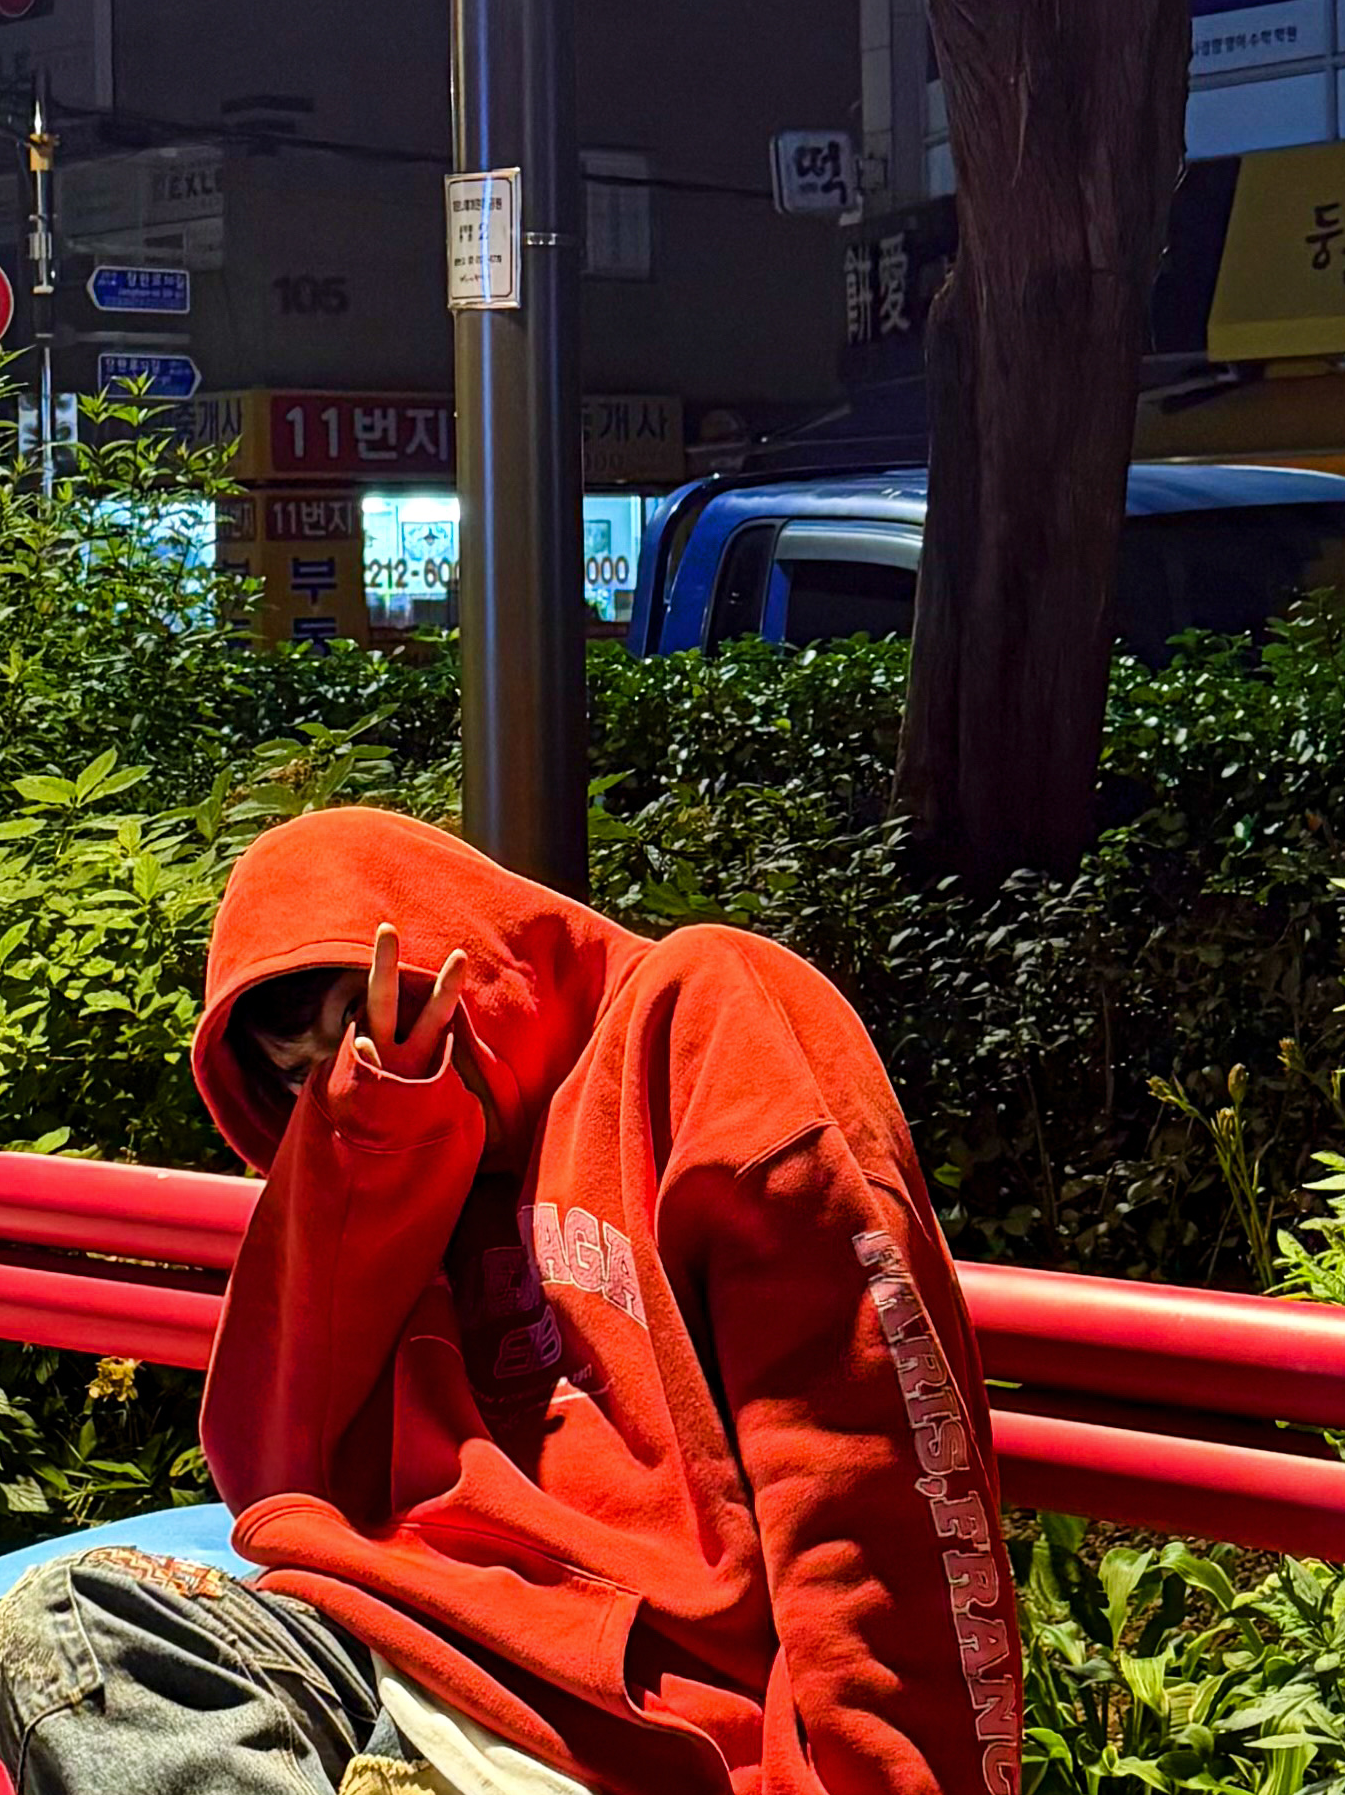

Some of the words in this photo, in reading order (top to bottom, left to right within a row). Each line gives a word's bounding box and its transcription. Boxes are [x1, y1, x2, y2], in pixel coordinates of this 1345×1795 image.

[795, 141, 847, 205] 떡
[274, 274, 350, 315] 105
[271, 500, 354, 537] 11번지
